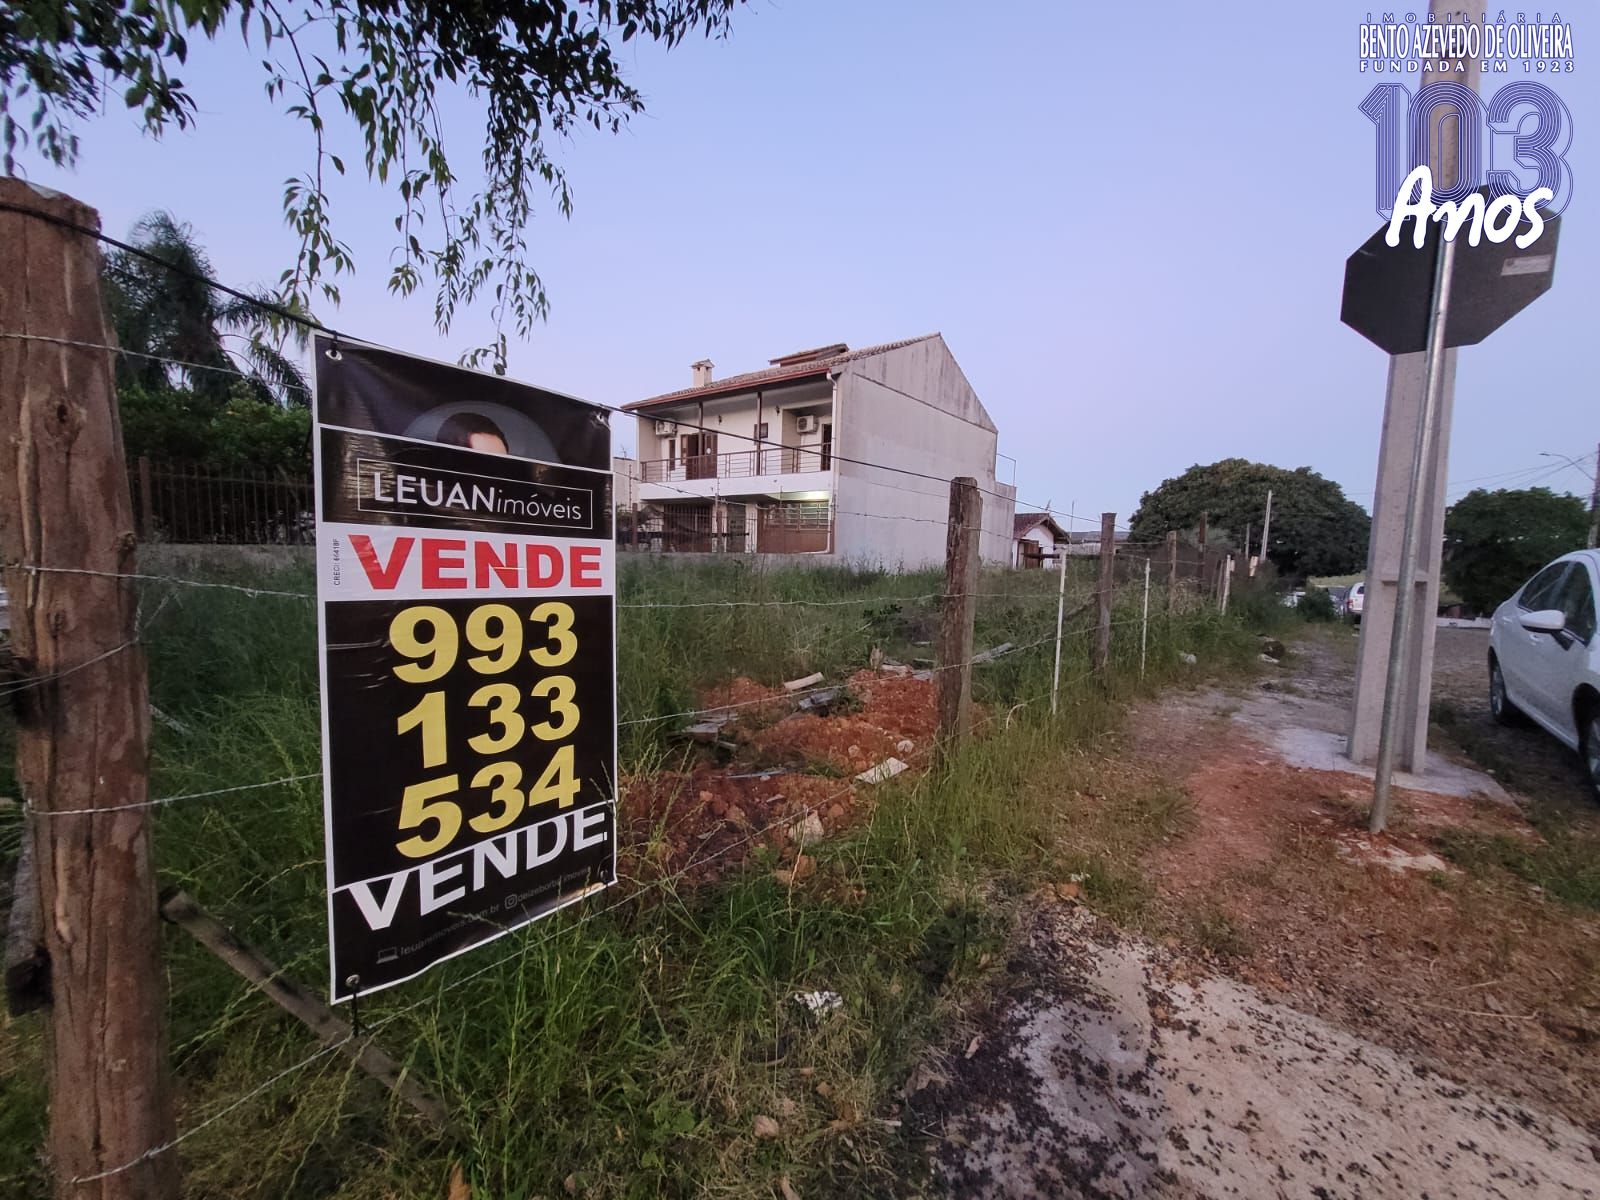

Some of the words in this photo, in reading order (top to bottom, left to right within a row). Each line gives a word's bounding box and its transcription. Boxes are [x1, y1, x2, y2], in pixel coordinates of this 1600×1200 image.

[347, 534, 603, 590] VENDE
[389, 601, 578, 684] 993
[397, 675, 581, 769] 133
[395, 744, 581, 858] 534
[349, 811, 606, 931] VENDE
